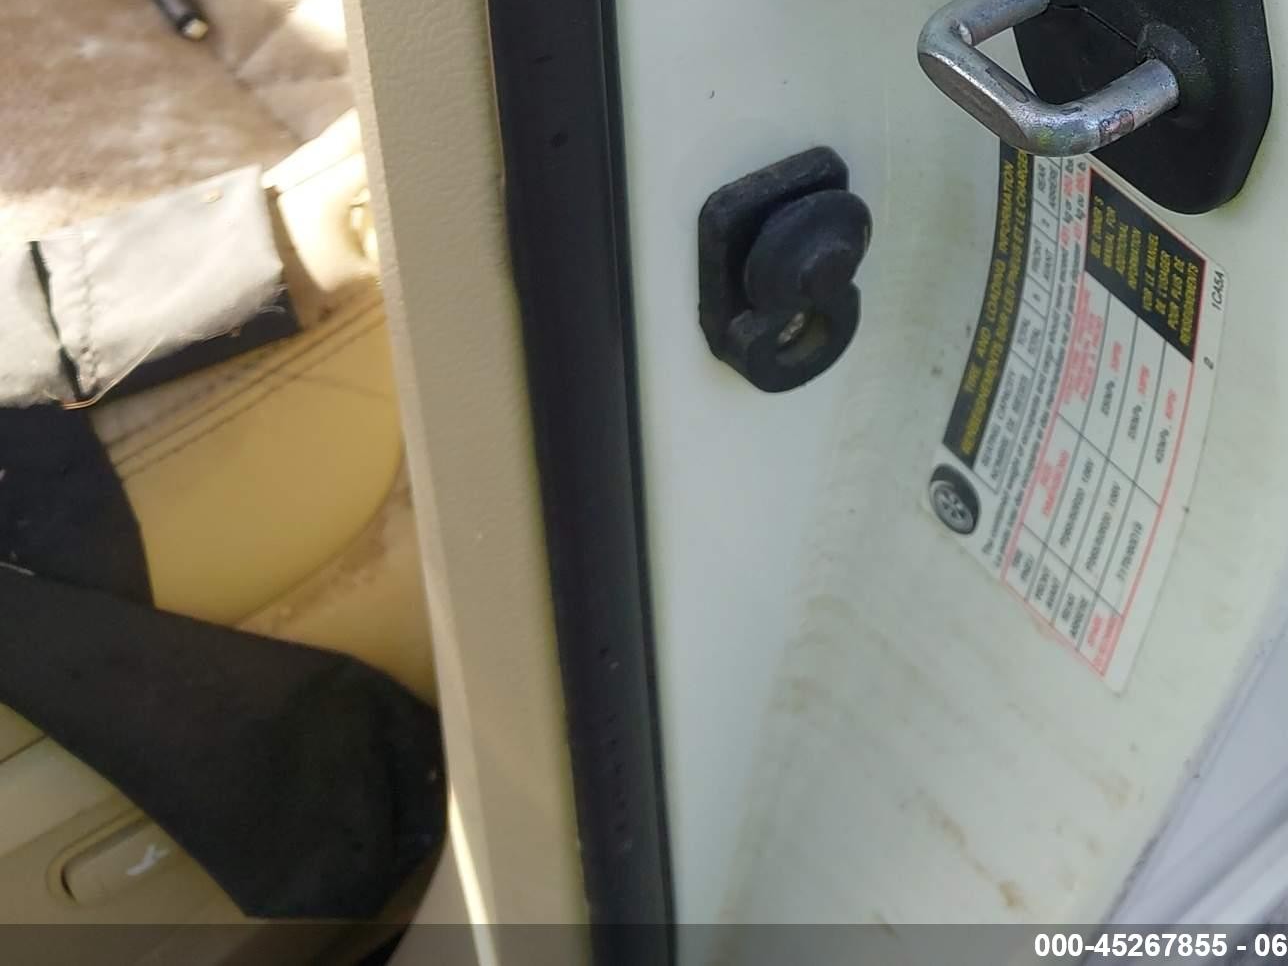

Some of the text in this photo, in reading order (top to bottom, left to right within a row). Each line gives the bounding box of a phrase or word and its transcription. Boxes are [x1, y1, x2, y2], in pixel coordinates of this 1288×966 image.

[1032, 239, 1041, 272] FRONT
[1104, 206, 1116, 267] MANUAL FOR
[1116, 226, 1128, 274] ADDITIONAL
[1147, 234, 1158, 269] MANUEL
[964, 162, 1013, 392] TIRE AND LOADING INFORMATION
[1043, 249, 1051, 281] AVANT
[1128, 229, 1141, 288] INFORMATION
[1158, 251, 1170, 297] L'USAGER
[1143, 287, 1152, 311] VOIR
[1171, 274, 1182, 300] PLUS
[1181, 264, 1197, 344] RENSEIGNEMENTS
[1212, 271, 1224, 309] 1CA5A
[1168, 302, 1179, 329] POUR
